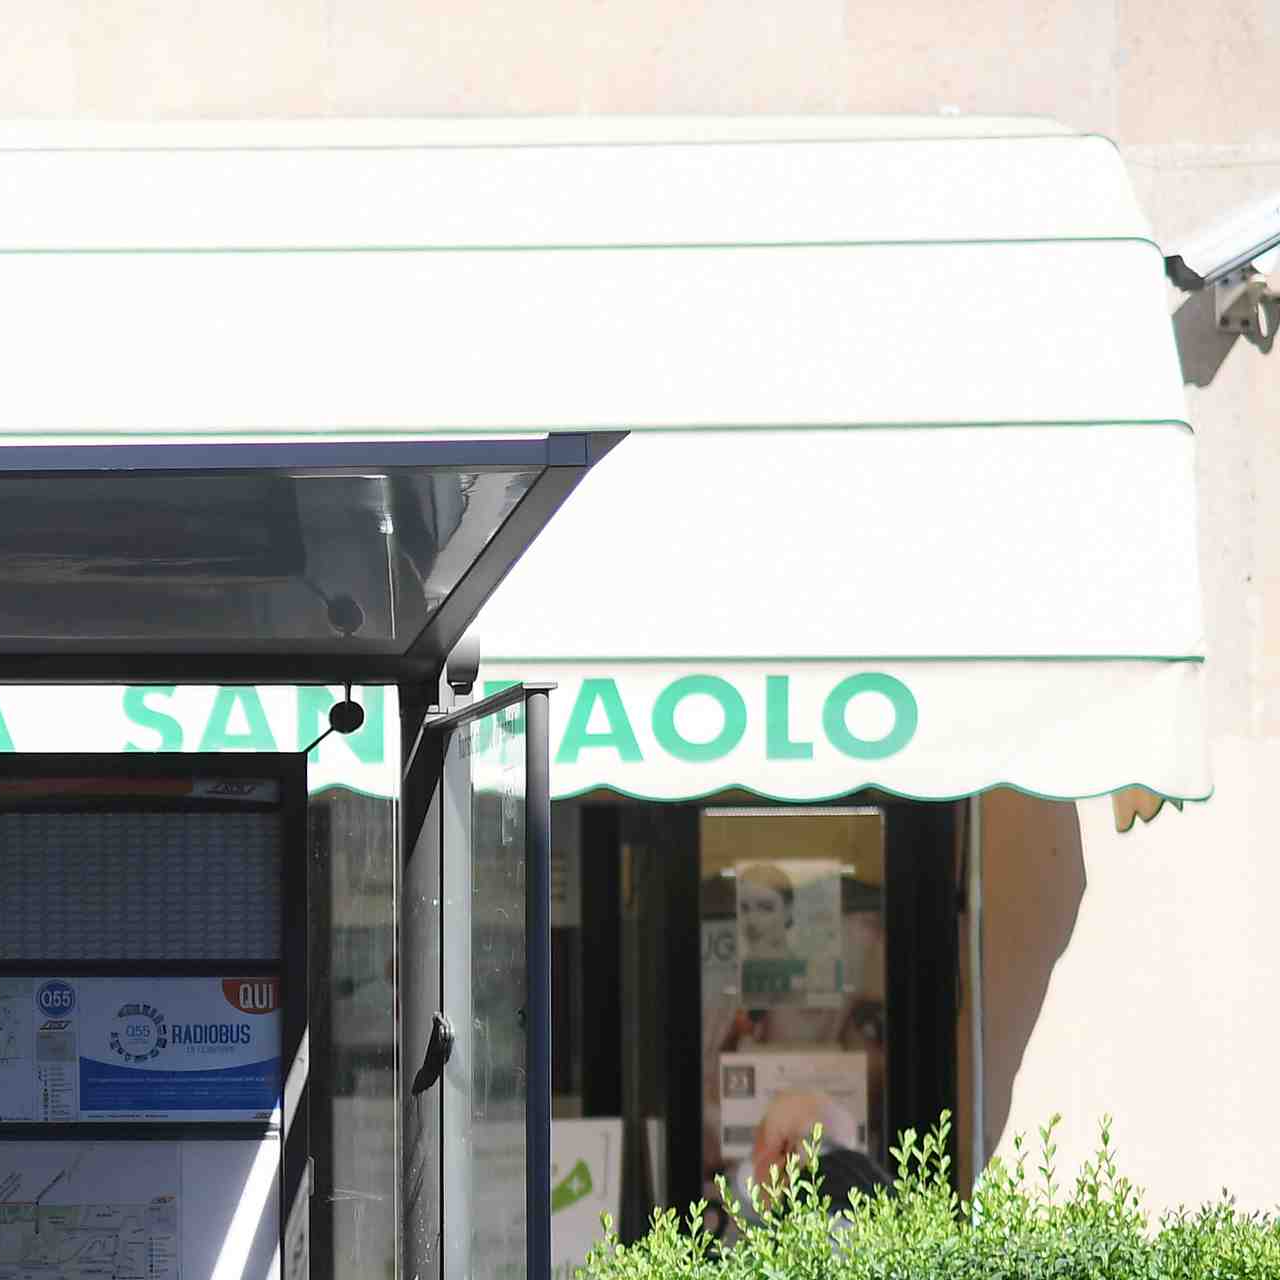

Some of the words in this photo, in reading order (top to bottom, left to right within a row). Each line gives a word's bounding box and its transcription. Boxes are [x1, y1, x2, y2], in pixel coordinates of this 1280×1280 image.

[122, 684, 385, 764] SAN
[240, 983, 273, 1010] QUI
[171, 1024, 252, 1046] RADIOBUS
